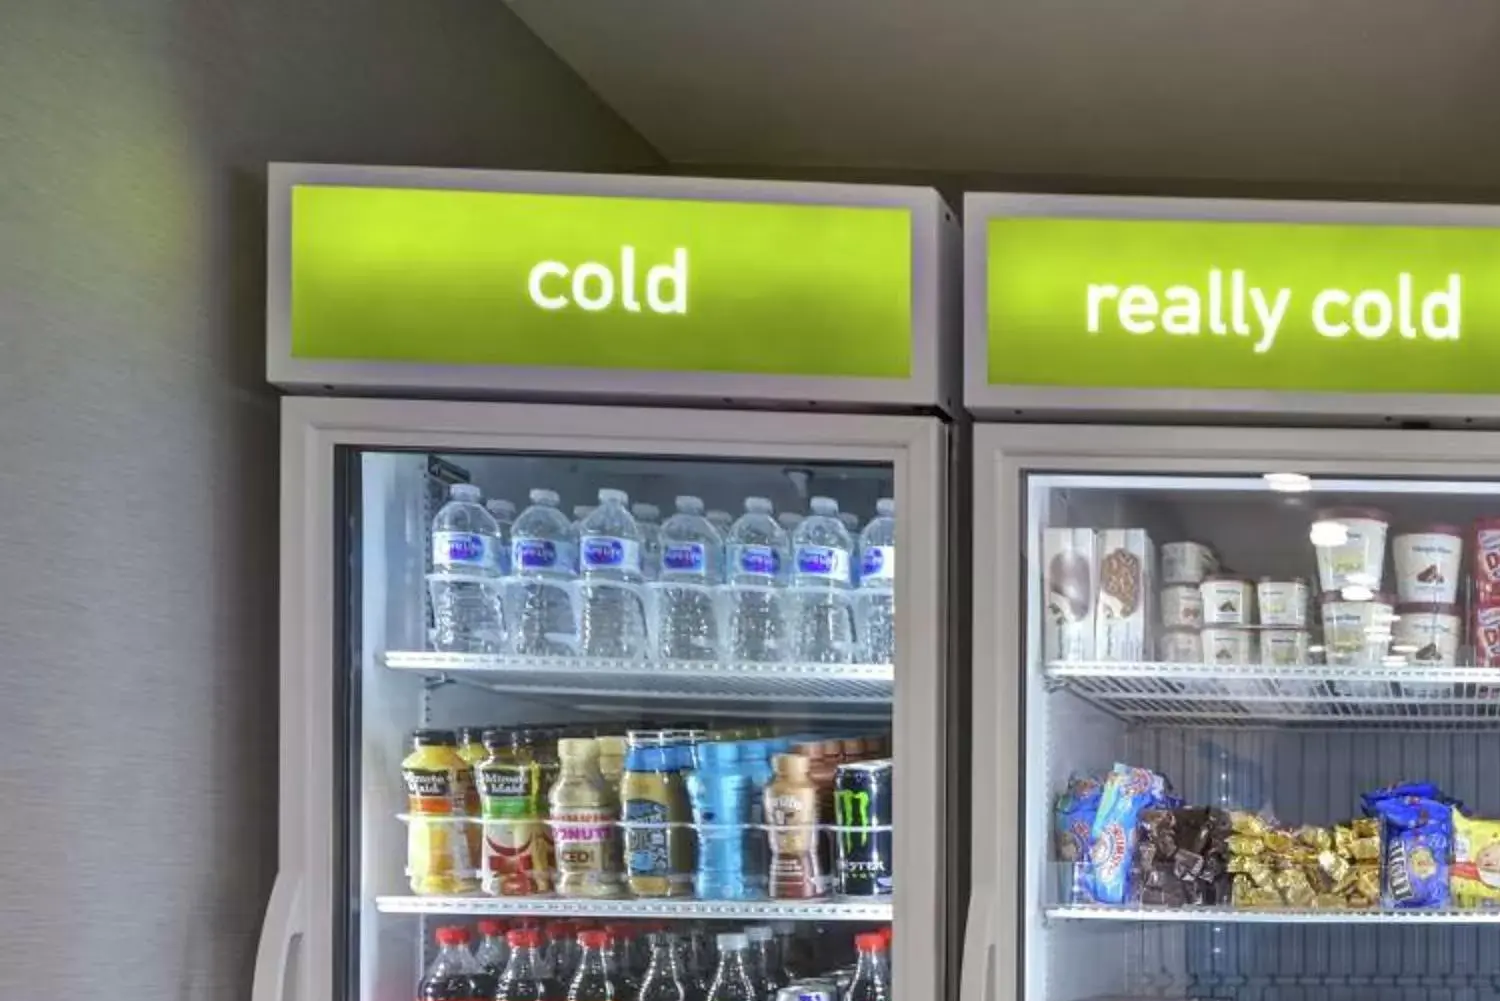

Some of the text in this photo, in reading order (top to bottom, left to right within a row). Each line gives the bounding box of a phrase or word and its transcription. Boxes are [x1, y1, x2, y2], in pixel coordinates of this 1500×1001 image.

[528, 244, 689, 315] cold
[1086, 269, 1462, 353] really cold
